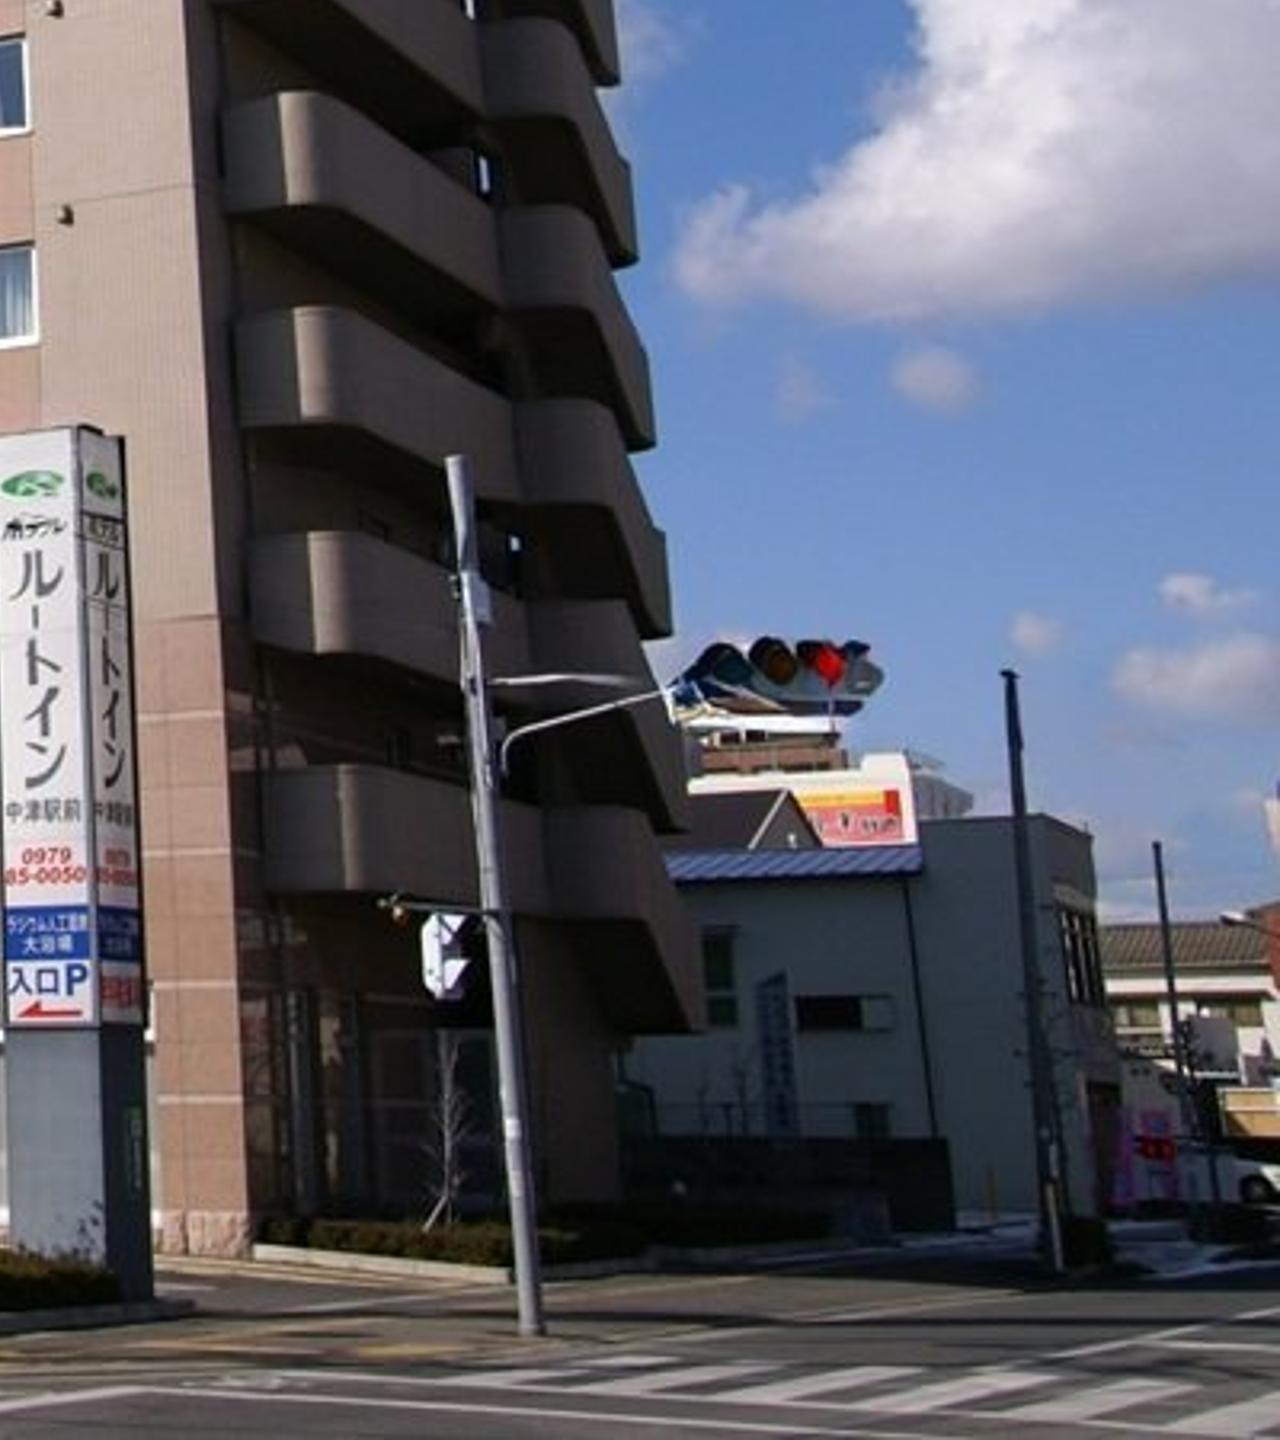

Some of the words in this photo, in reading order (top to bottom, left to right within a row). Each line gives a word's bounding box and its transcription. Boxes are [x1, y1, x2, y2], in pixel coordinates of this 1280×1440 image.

[2, 516, 67, 541] ホテル
[9, 549, 67, 789] ルートイン
[92, 551, 125, 788] ルートイン
[21, 846, 72, 865] 0979
